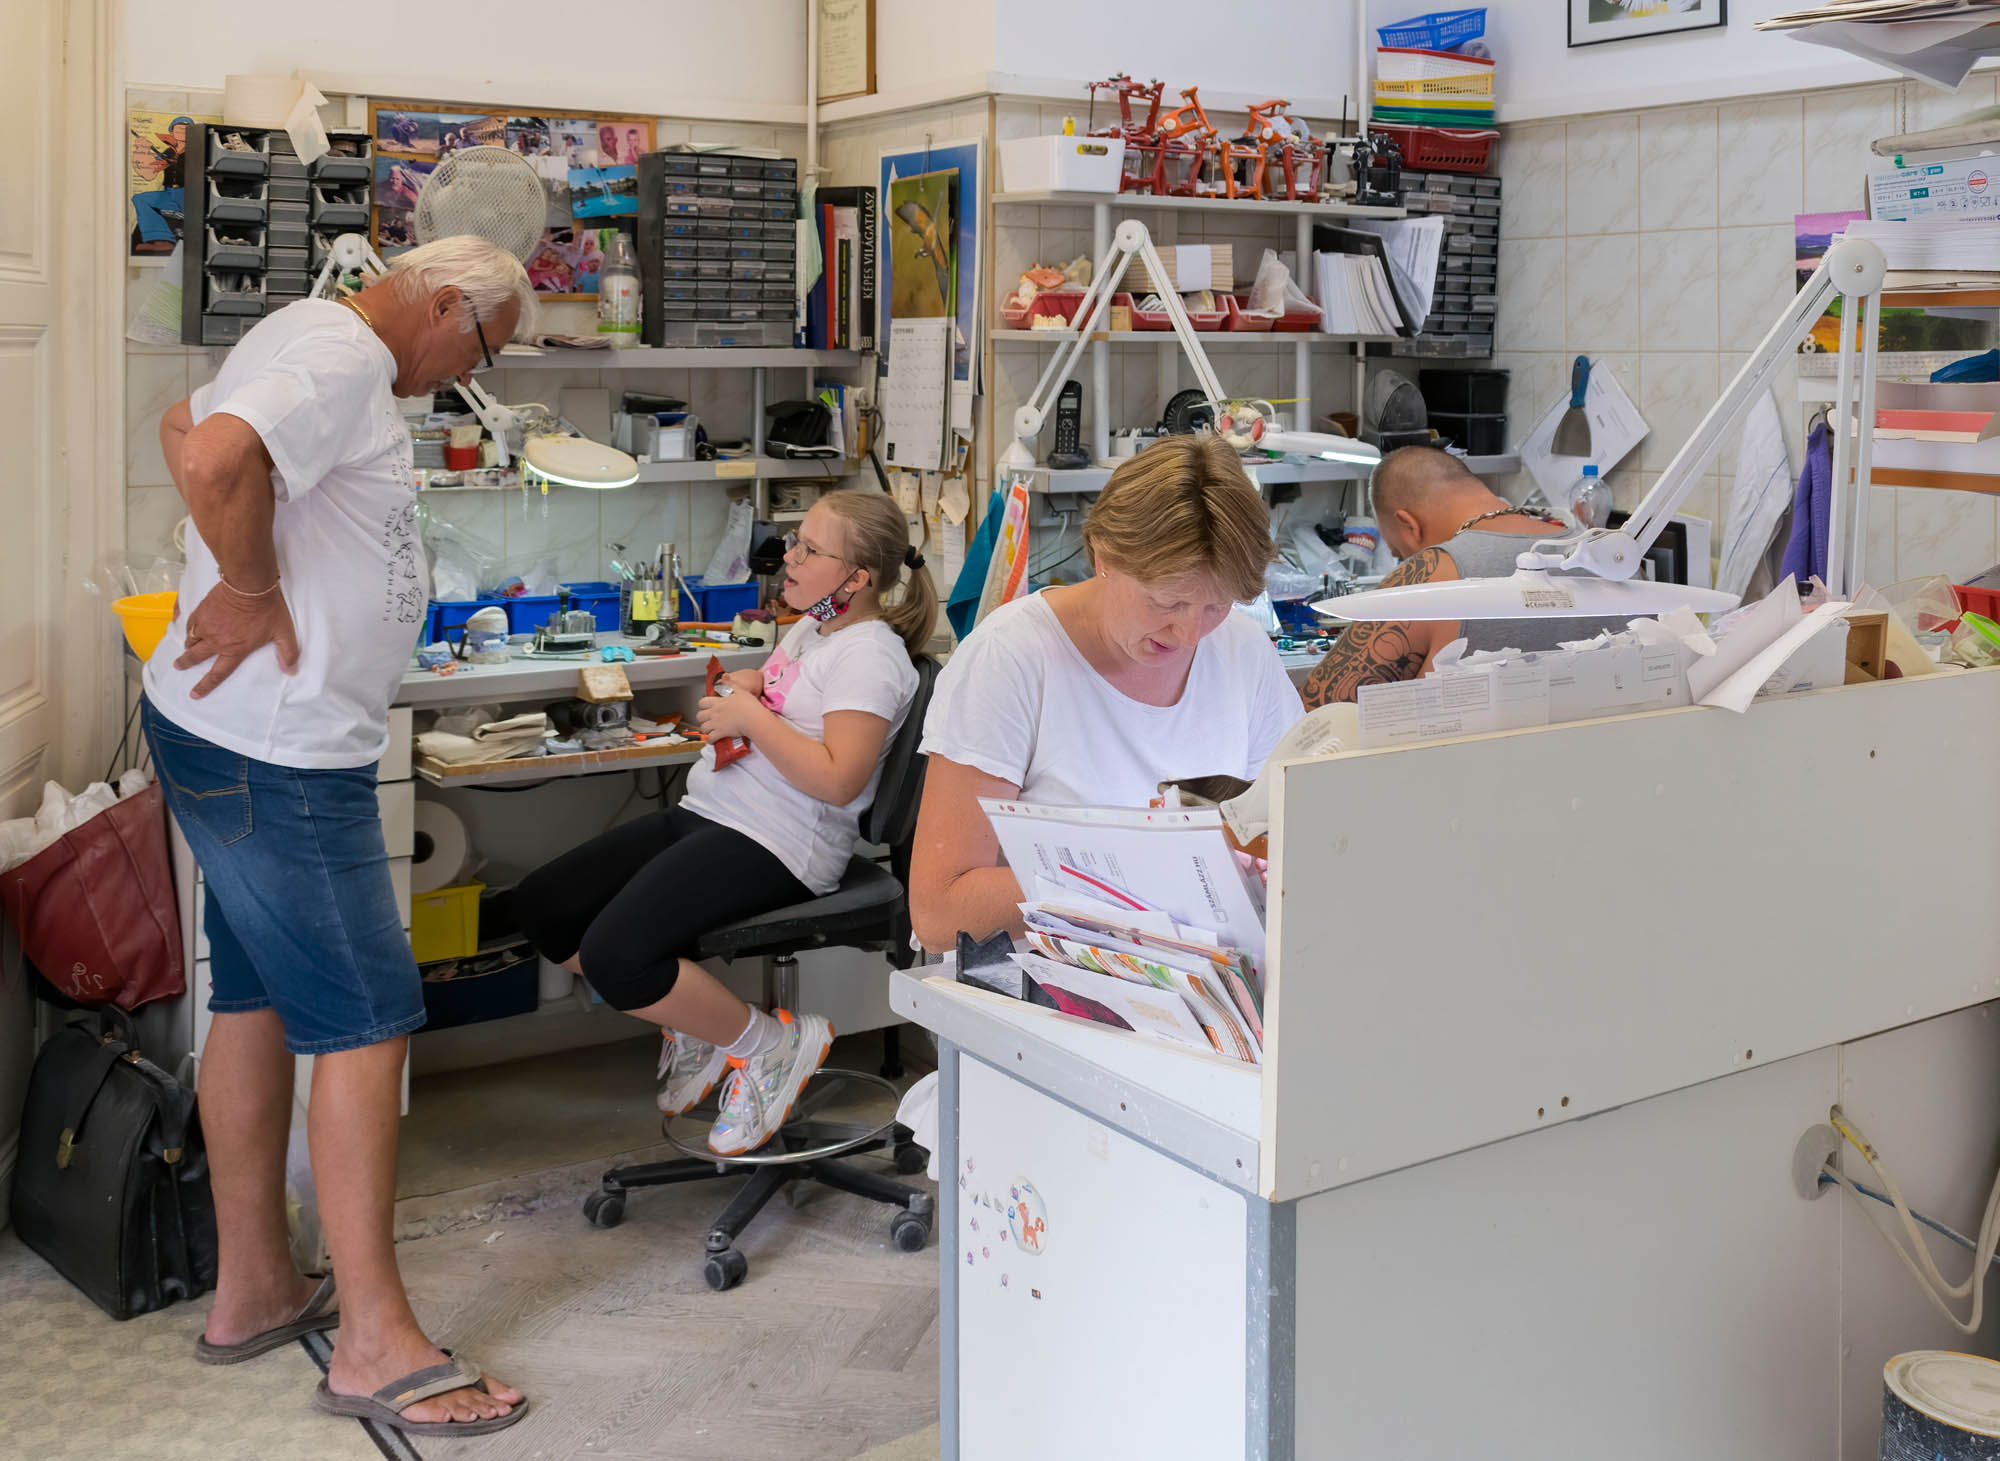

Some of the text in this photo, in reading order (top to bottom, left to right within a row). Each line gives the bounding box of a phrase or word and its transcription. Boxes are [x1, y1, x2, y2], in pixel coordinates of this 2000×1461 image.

[862, 192, 875, 299] KÉPES VILÁGATLASZ
[1802, 333, 1817, 354] 8
[383, 505, 398, 547] DANCE
[381, 559, 397, 622] ELEPHAN
